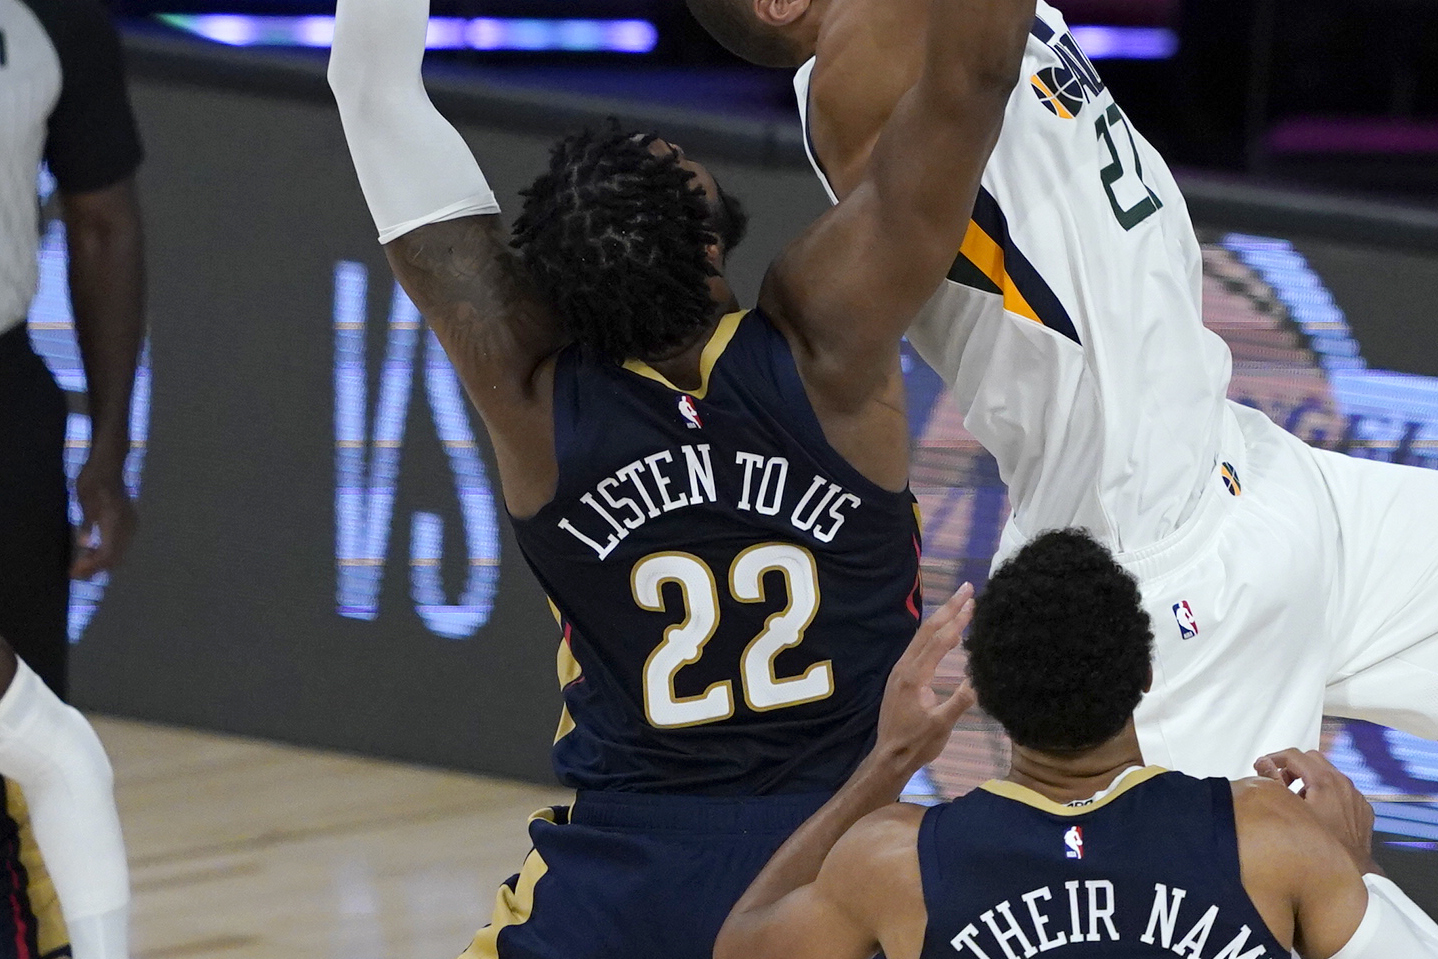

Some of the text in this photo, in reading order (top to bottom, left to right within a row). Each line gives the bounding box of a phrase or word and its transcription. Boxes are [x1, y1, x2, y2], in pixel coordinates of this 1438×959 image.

[332, 259, 502, 640] VS
[557, 443, 862, 561] LISTEN TO US
[630, 541, 835, 730] 22
[950, 879, 1121, 959] THEIR
